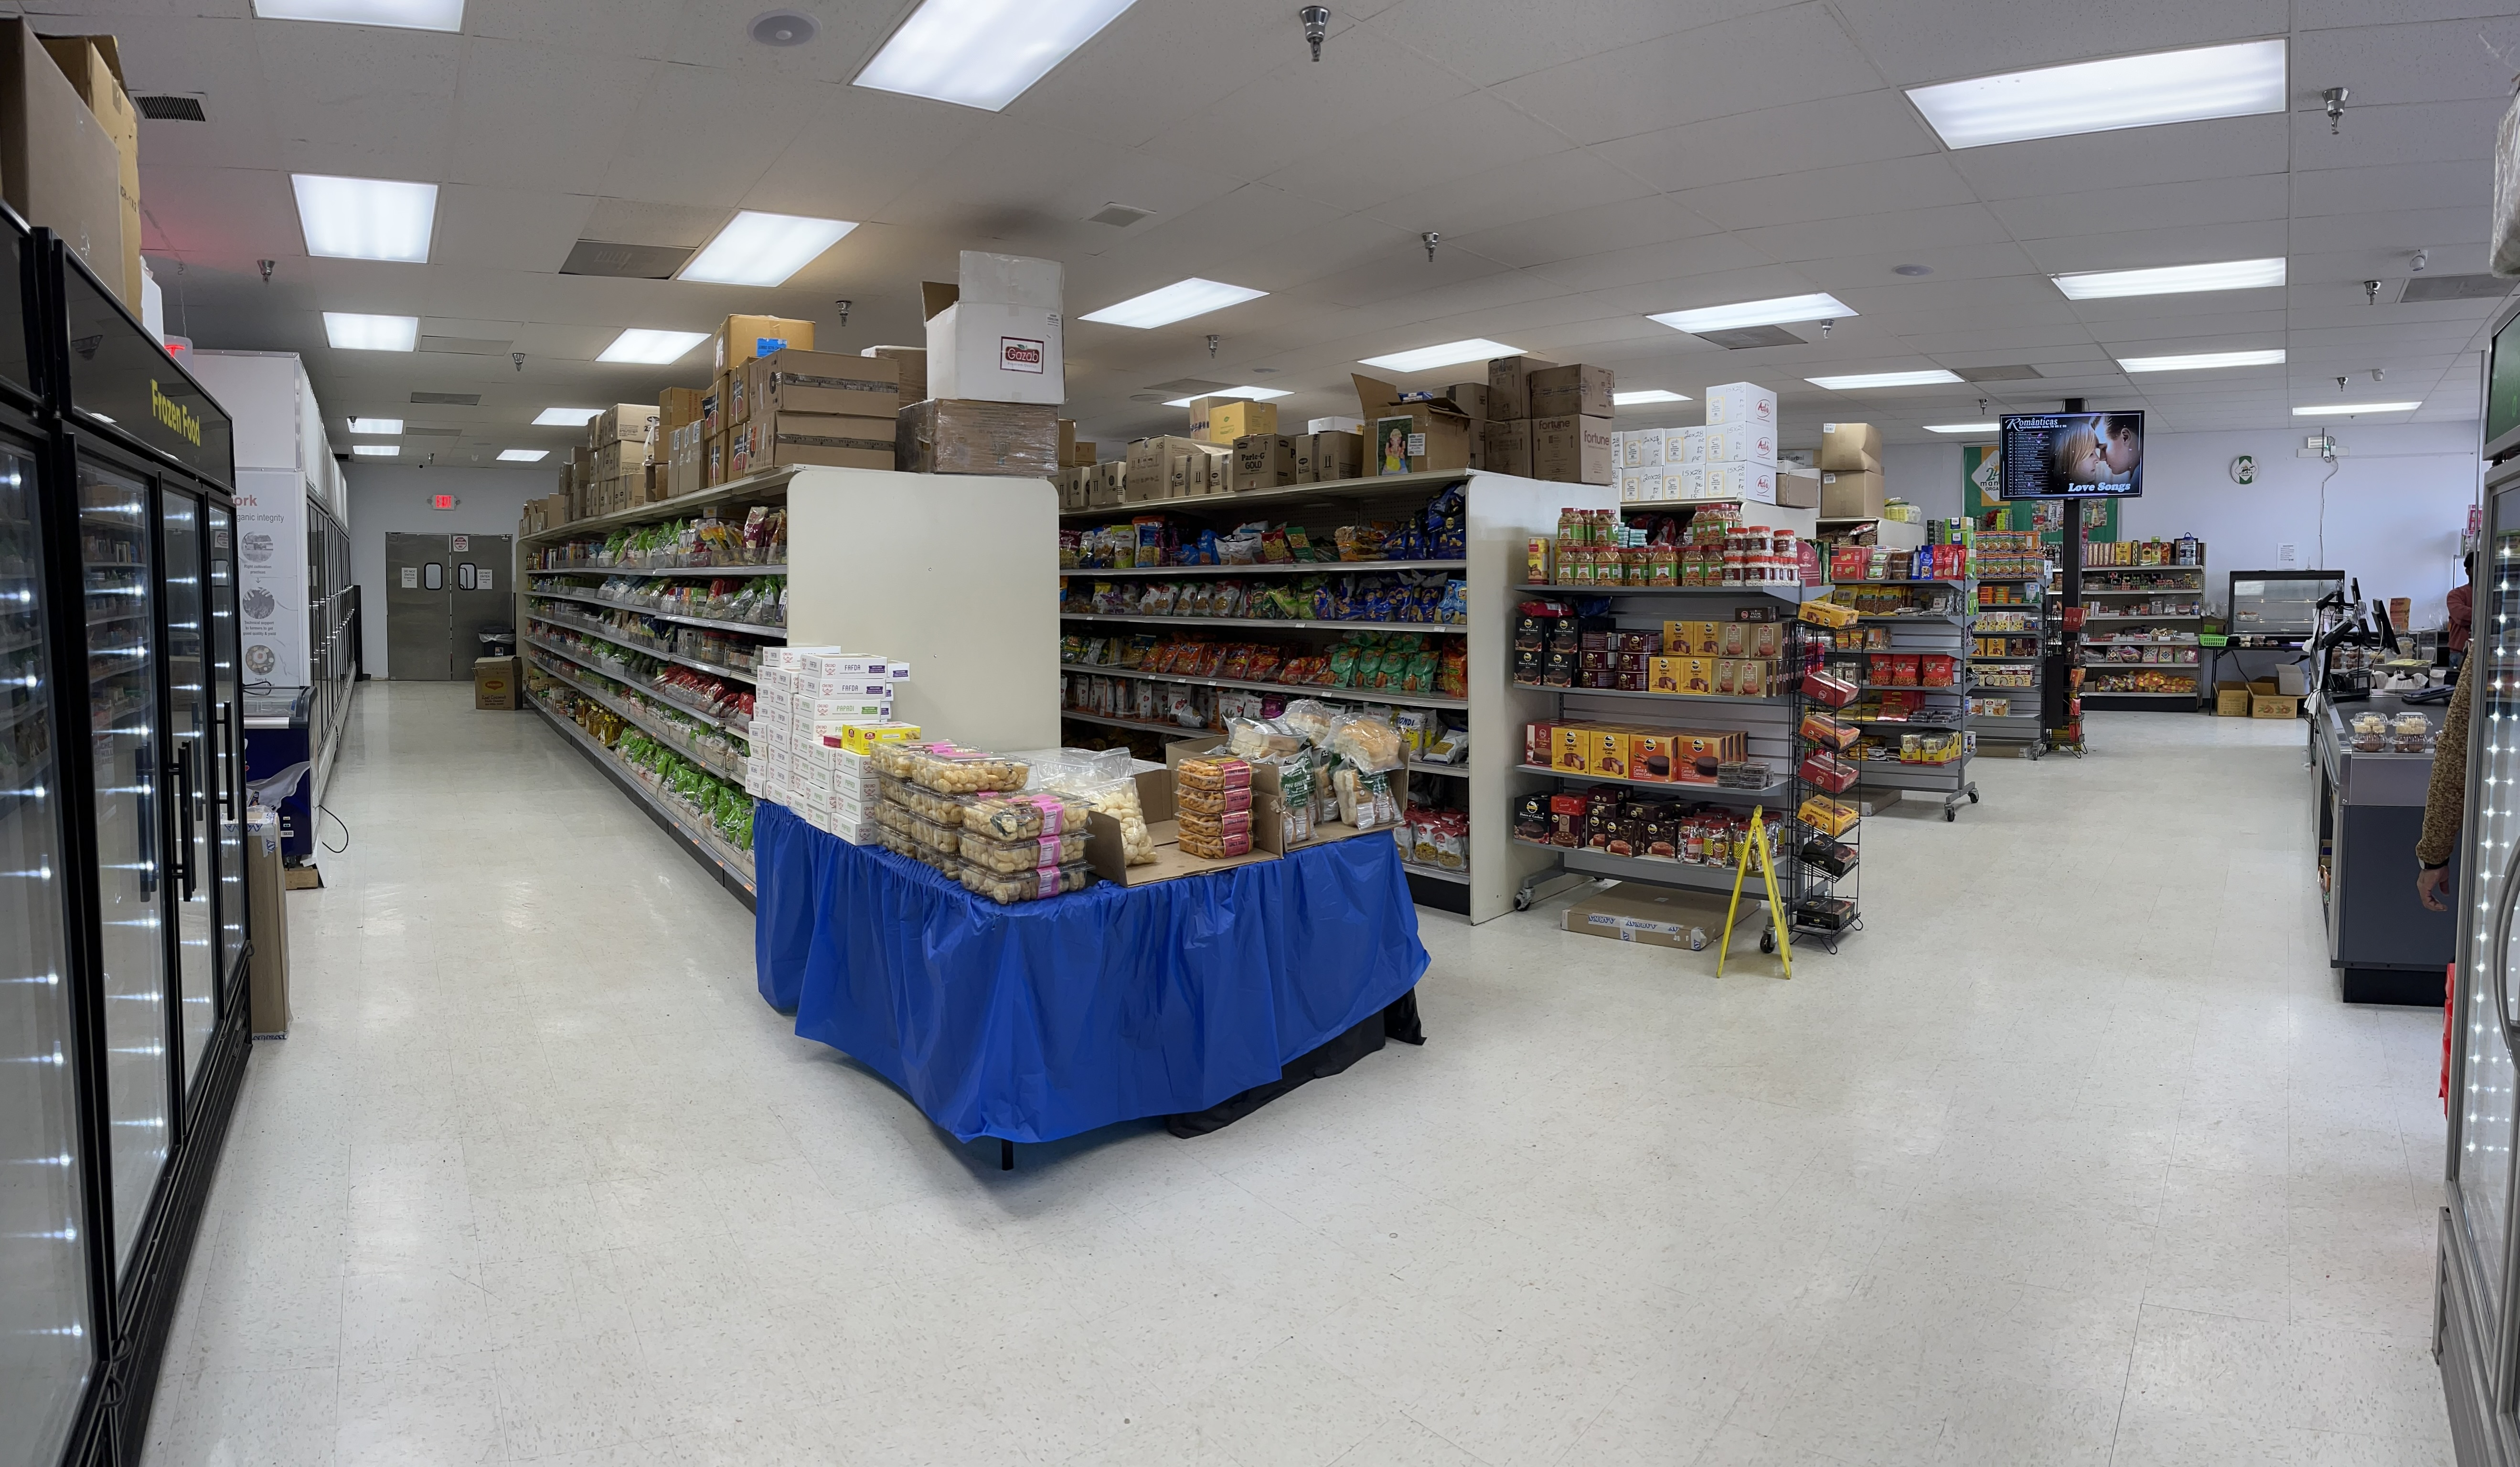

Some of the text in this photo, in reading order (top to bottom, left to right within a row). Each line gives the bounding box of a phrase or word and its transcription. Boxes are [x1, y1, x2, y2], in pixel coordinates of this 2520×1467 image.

[1008, 348, 1038, 362] Gazab
[150, 378, 201, 447] Frozen Food
[1539, 420, 1570, 430] fortune
[2005, 417, 2058, 432] Românticas
[1584, 430, 1610, 446] fortune
[1241, 452, 1265, 461] Parle-G
[1245, 461, 1262, 470] GOLD
[2068, 482, 2131, 492] Love Songs
[234, 495, 257, 507] ork
[436, 495, 451, 508] EXIT
[237, 513, 284, 523] ganic integrity
[1398, 717, 1415, 726] ONDI
[1809, 808, 1823, 818] Jackfruit
